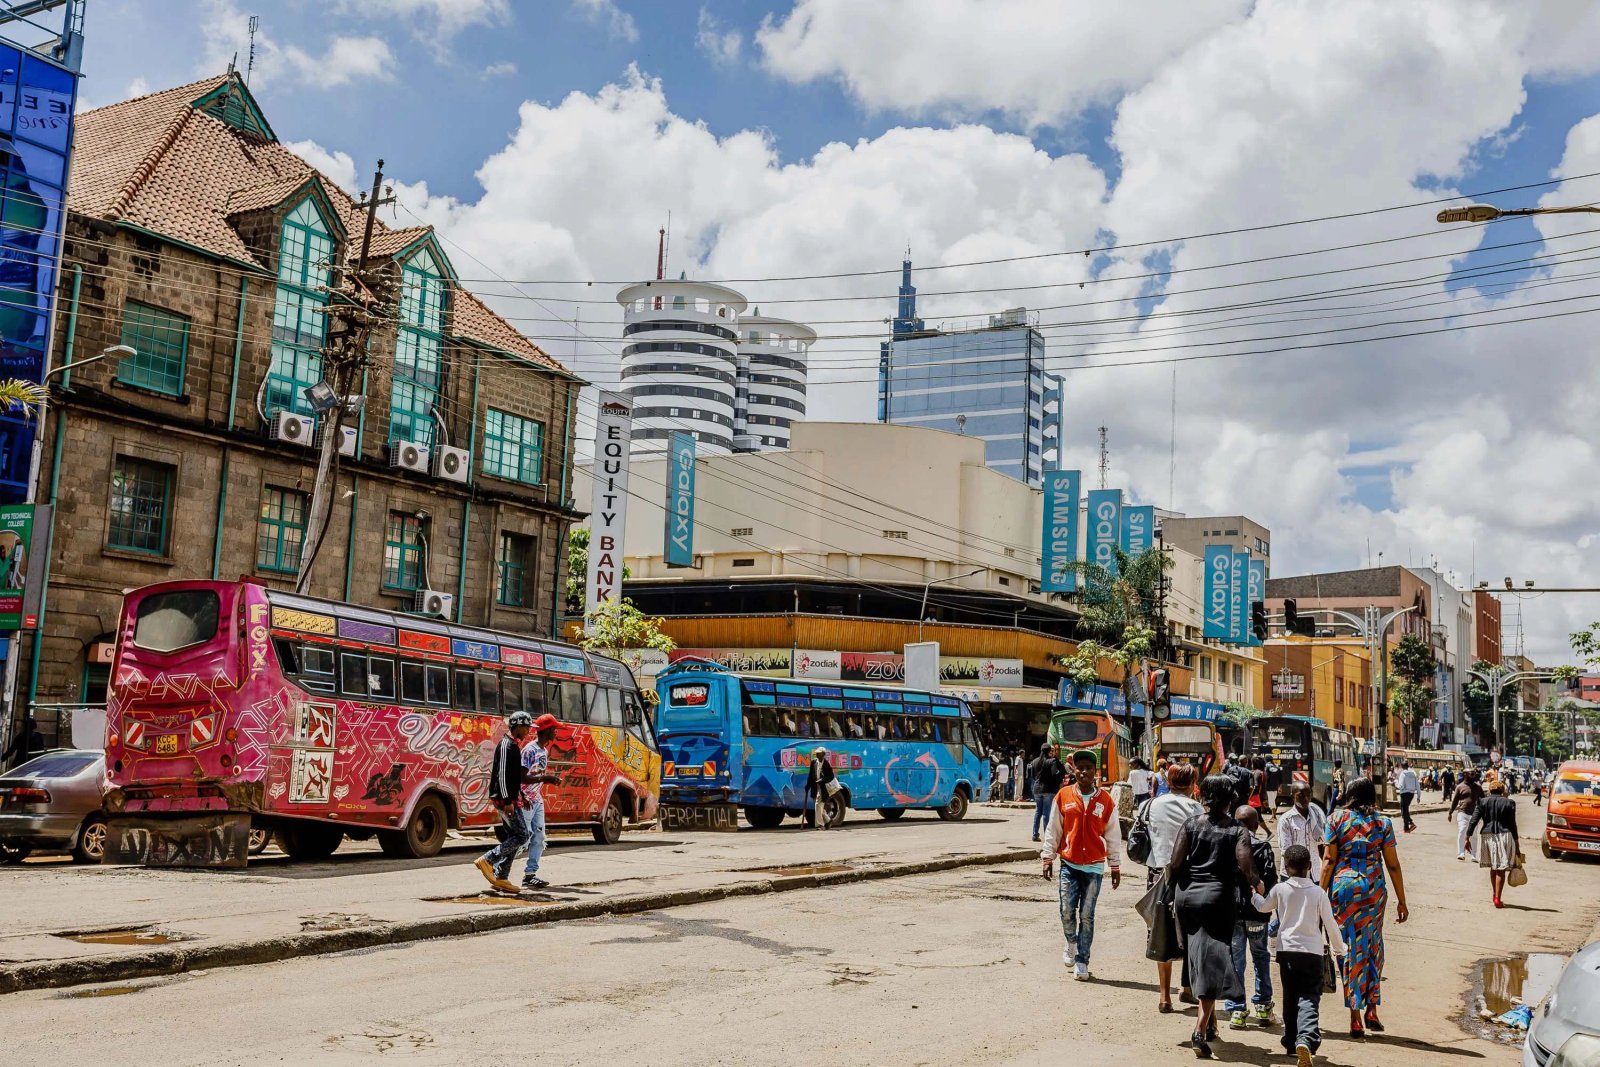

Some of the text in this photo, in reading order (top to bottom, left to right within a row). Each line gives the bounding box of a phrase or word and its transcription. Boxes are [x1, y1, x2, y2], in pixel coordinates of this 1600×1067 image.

[601, 408, 630, 416] EQUITY
[672, 448, 693, 552] Galaxy
[596, 425, 622, 603] EQUITY BANK
[8, 520, 25, 528] COLLEGE
[1050, 478, 1070, 584] SAMSUNG
[1206, 554, 1230, 629] Galaxy
[1232, 558, 1242, 638] SAMSUNG
[810, 659, 839, 668] zodiak
[994, 666, 1021, 676] zodiak
[157, 734, 171, 743] KCC
[157, 743, 176, 752] 648S
[337, 802, 367, 810] FOXY
[659, 807, 737, 828] PERPETUAL
